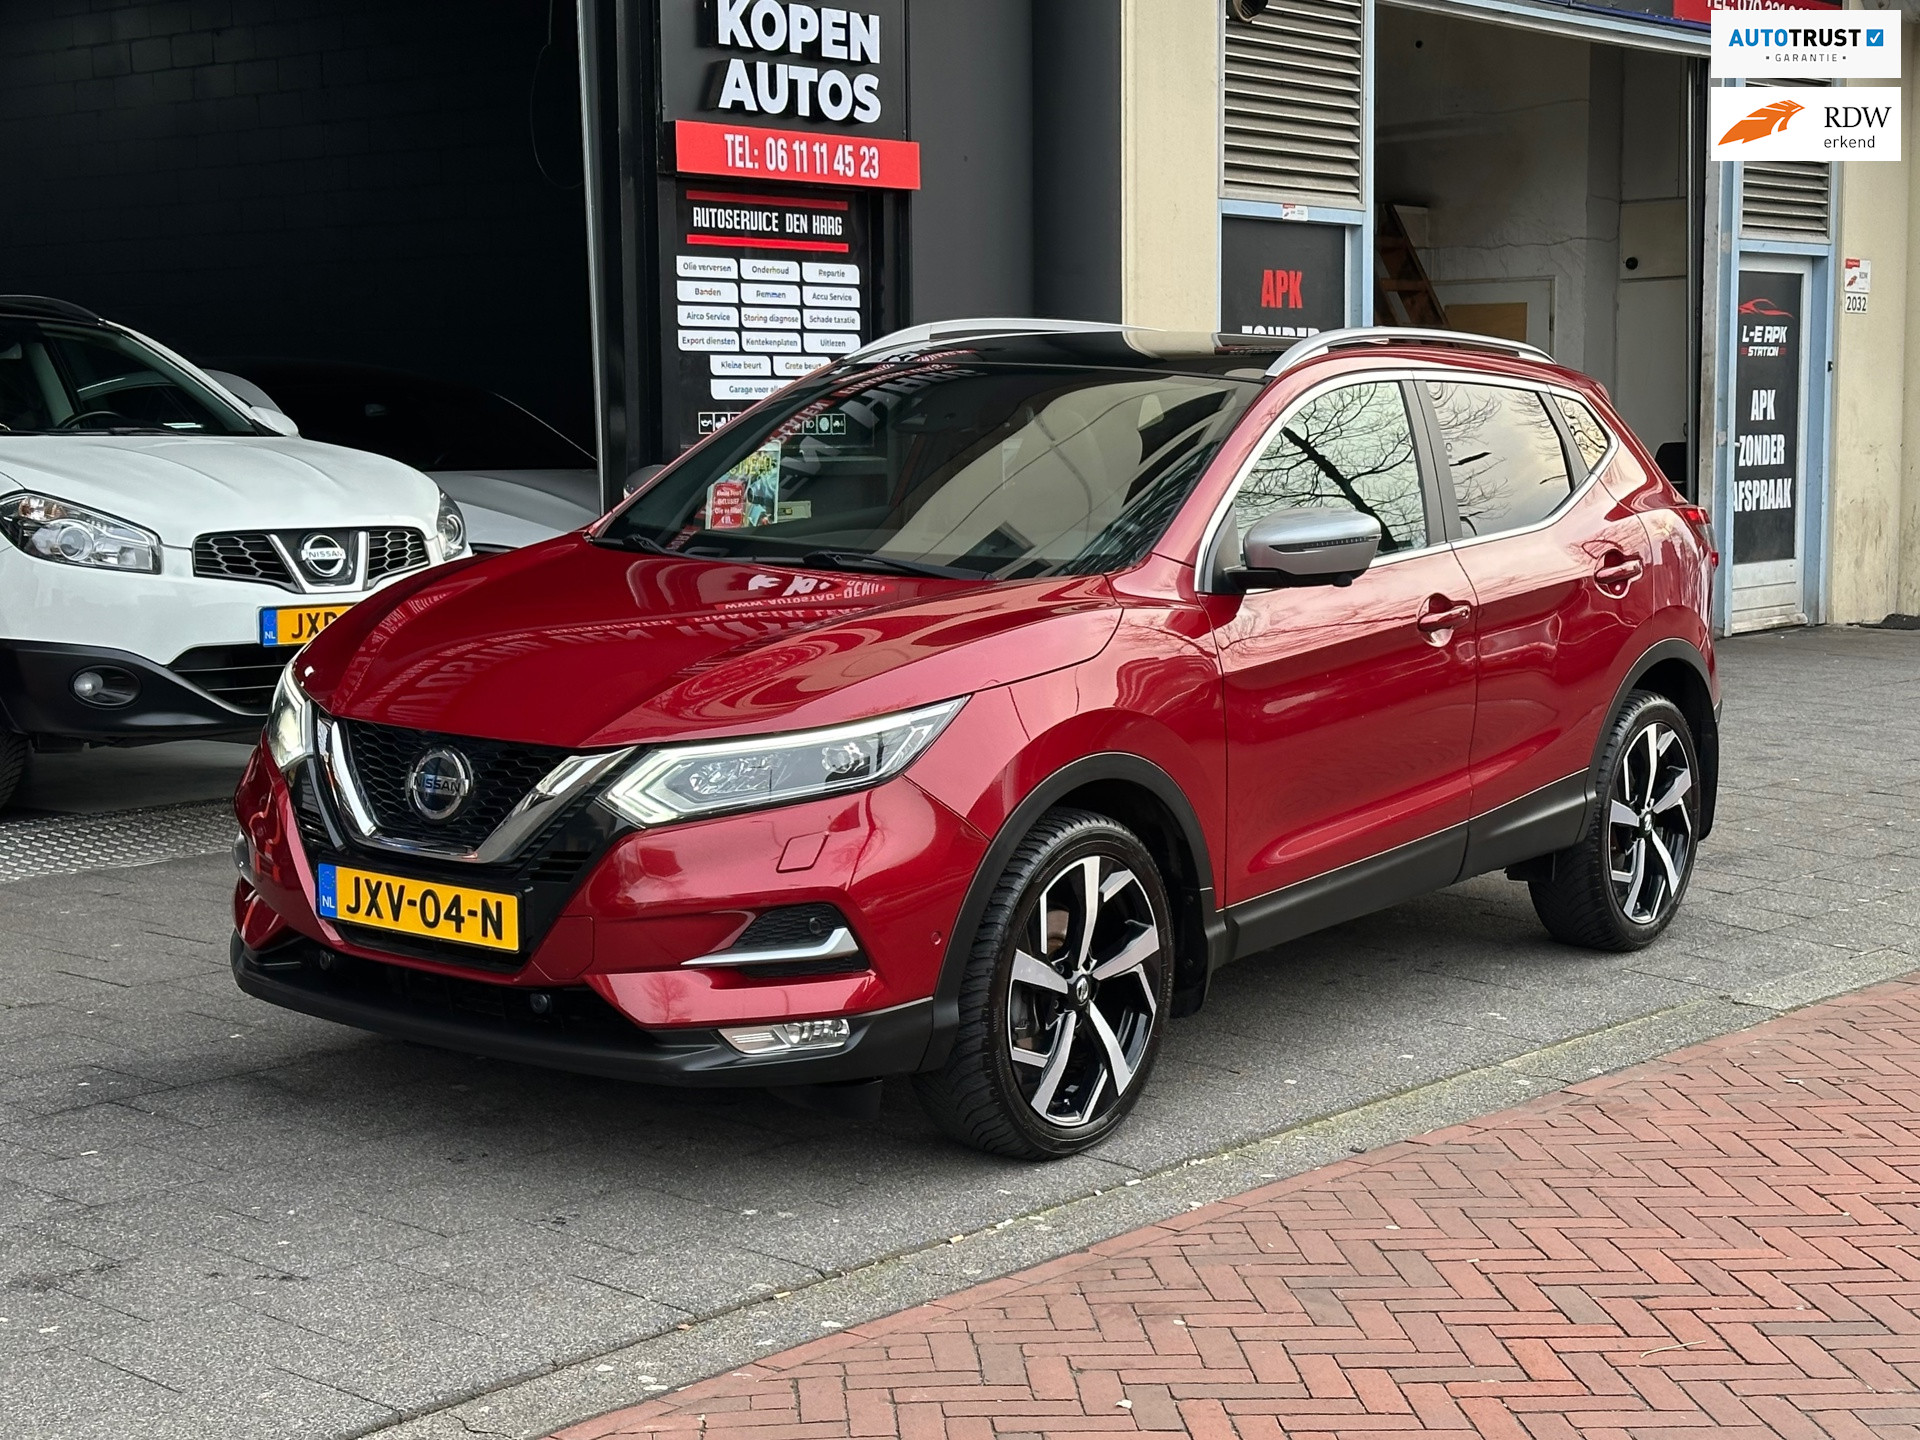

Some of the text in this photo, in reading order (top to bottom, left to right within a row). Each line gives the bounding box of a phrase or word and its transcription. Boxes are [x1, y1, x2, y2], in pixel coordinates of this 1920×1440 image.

[717, 0, 881, 64] KOPEN
[718, 58, 882, 123] AUTOS
[724, 133, 879, 179] TEL: 06 11 11 45 23
[693, 206, 843, 236] AUTOSERVICE DEN HAAG
[683, 262, 732, 272] Olie verversen
[751, 265, 790, 275] Onderhoud
[694, 287, 722, 296] Banden
[1261, 269, 1303, 308] APK
[756, 290, 787, 299] Remmen
[812, 292, 853, 302] Accu Service
[1847, 296, 1867, 311] 2032
[686, 311, 731, 321] Airco Service
[744, 313, 799, 324] Storing diagnose
[809, 315, 833, 324] Schade
[1764, 326, 1788, 343] APK
[682, 336, 736, 345] Export diensten
[746, 338, 798, 348] Kentekenplaten
[820, 338, 846, 347] Uitlezen
[1748, 346, 1779, 357] STATION
[720, 360, 762, 369] Kleine beurt
[785, 362, 803, 370] Grote
[729, 385, 753, 395] Garage
[1751, 389, 1776, 421] APK
[1738, 434, 1786, 467] ZONDER
[308, 548, 344, 559] NISSAN
[264, 630, 277, 640] NL
[413, 774, 461, 792] NISSAN
[322, 895, 335, 909] NL
[346, 876, 503, 941] JXV-04-N
